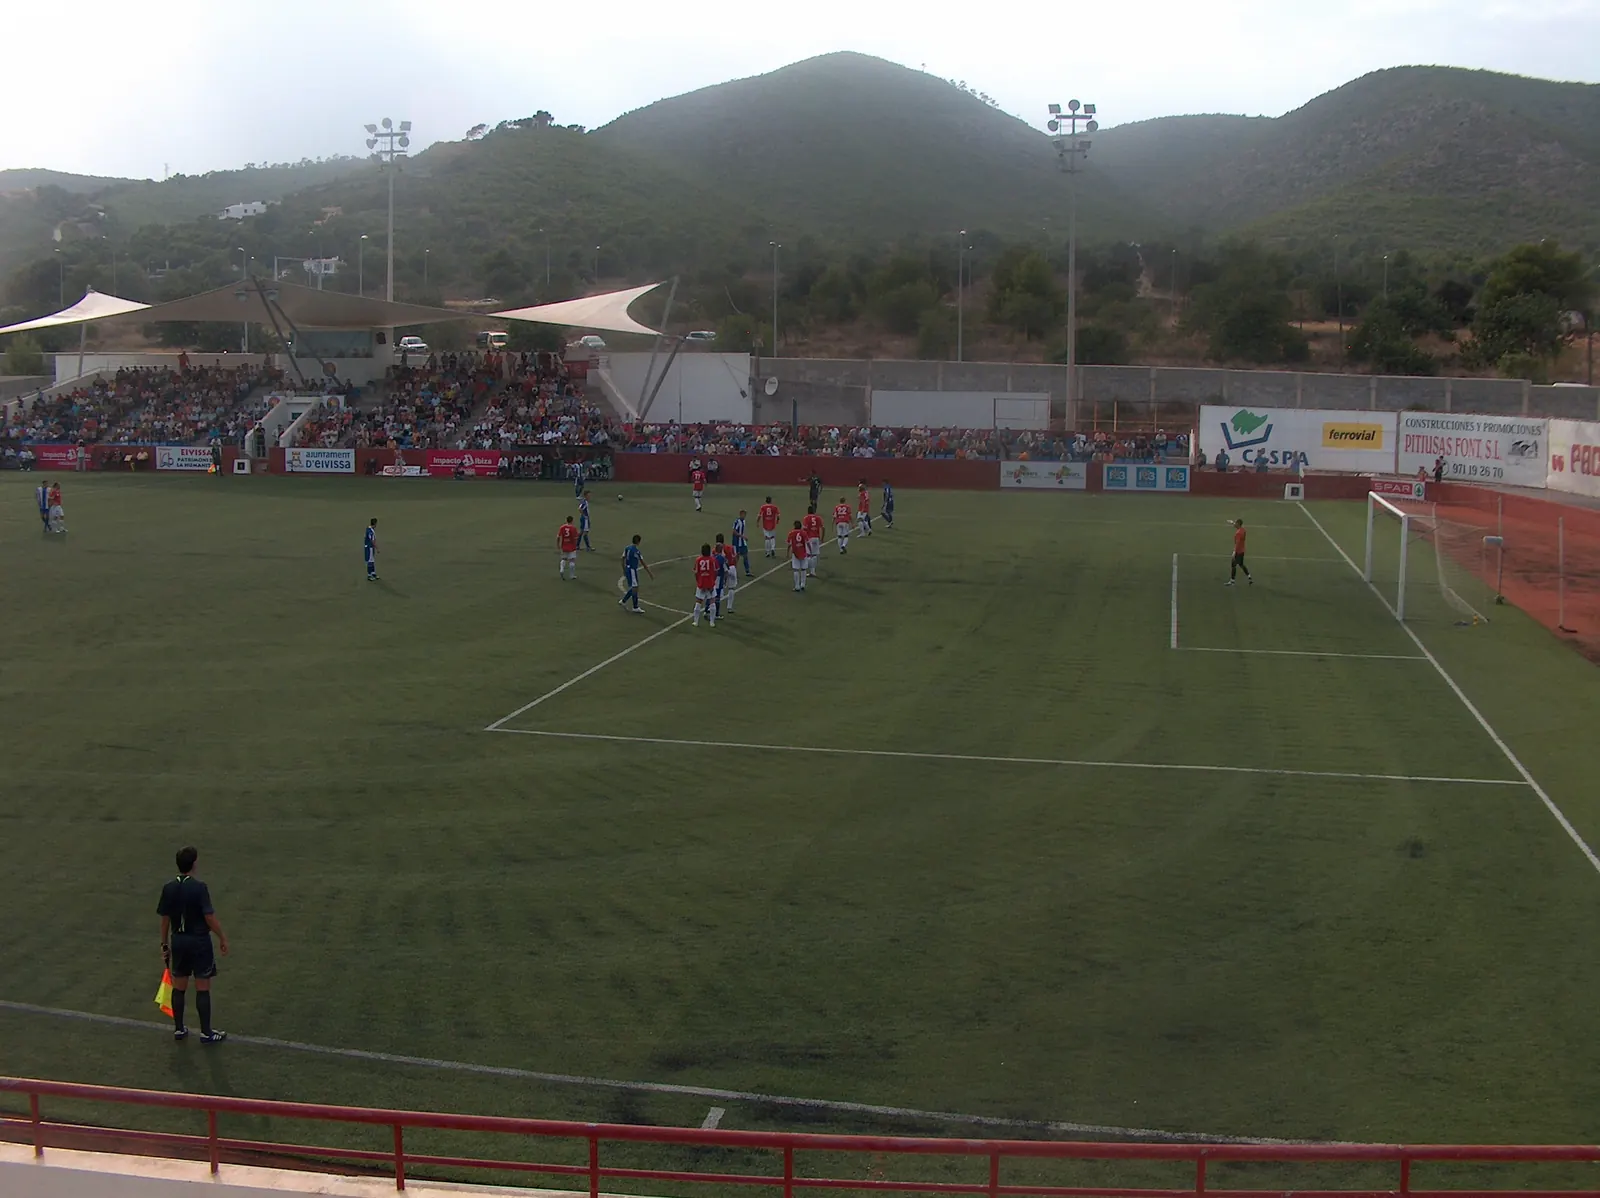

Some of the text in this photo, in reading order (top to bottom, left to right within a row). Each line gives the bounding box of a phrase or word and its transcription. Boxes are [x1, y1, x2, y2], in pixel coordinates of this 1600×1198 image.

[1405, 417, 1542, 436] CONSTRUCCIONES Y PROMOCIONES
[1328, 428, 1377, 441] ferrovial
[1404, 433, 1453, 456] PITIUSAS
[433, 457, 461, 465] Impacto
[1242, 448, 1309, 466] CSPA
[1452, 463, 1504, 478] 971 19 26 70
[1374, 482, 1410, 494] SPAR
[837, 506, 847, 515] 22
[811, 517, 817, 526] 5
[564, 528, 570, 537] 3
[796, 532, 802, 542] 6
[699, 559, 710, 571] 21
